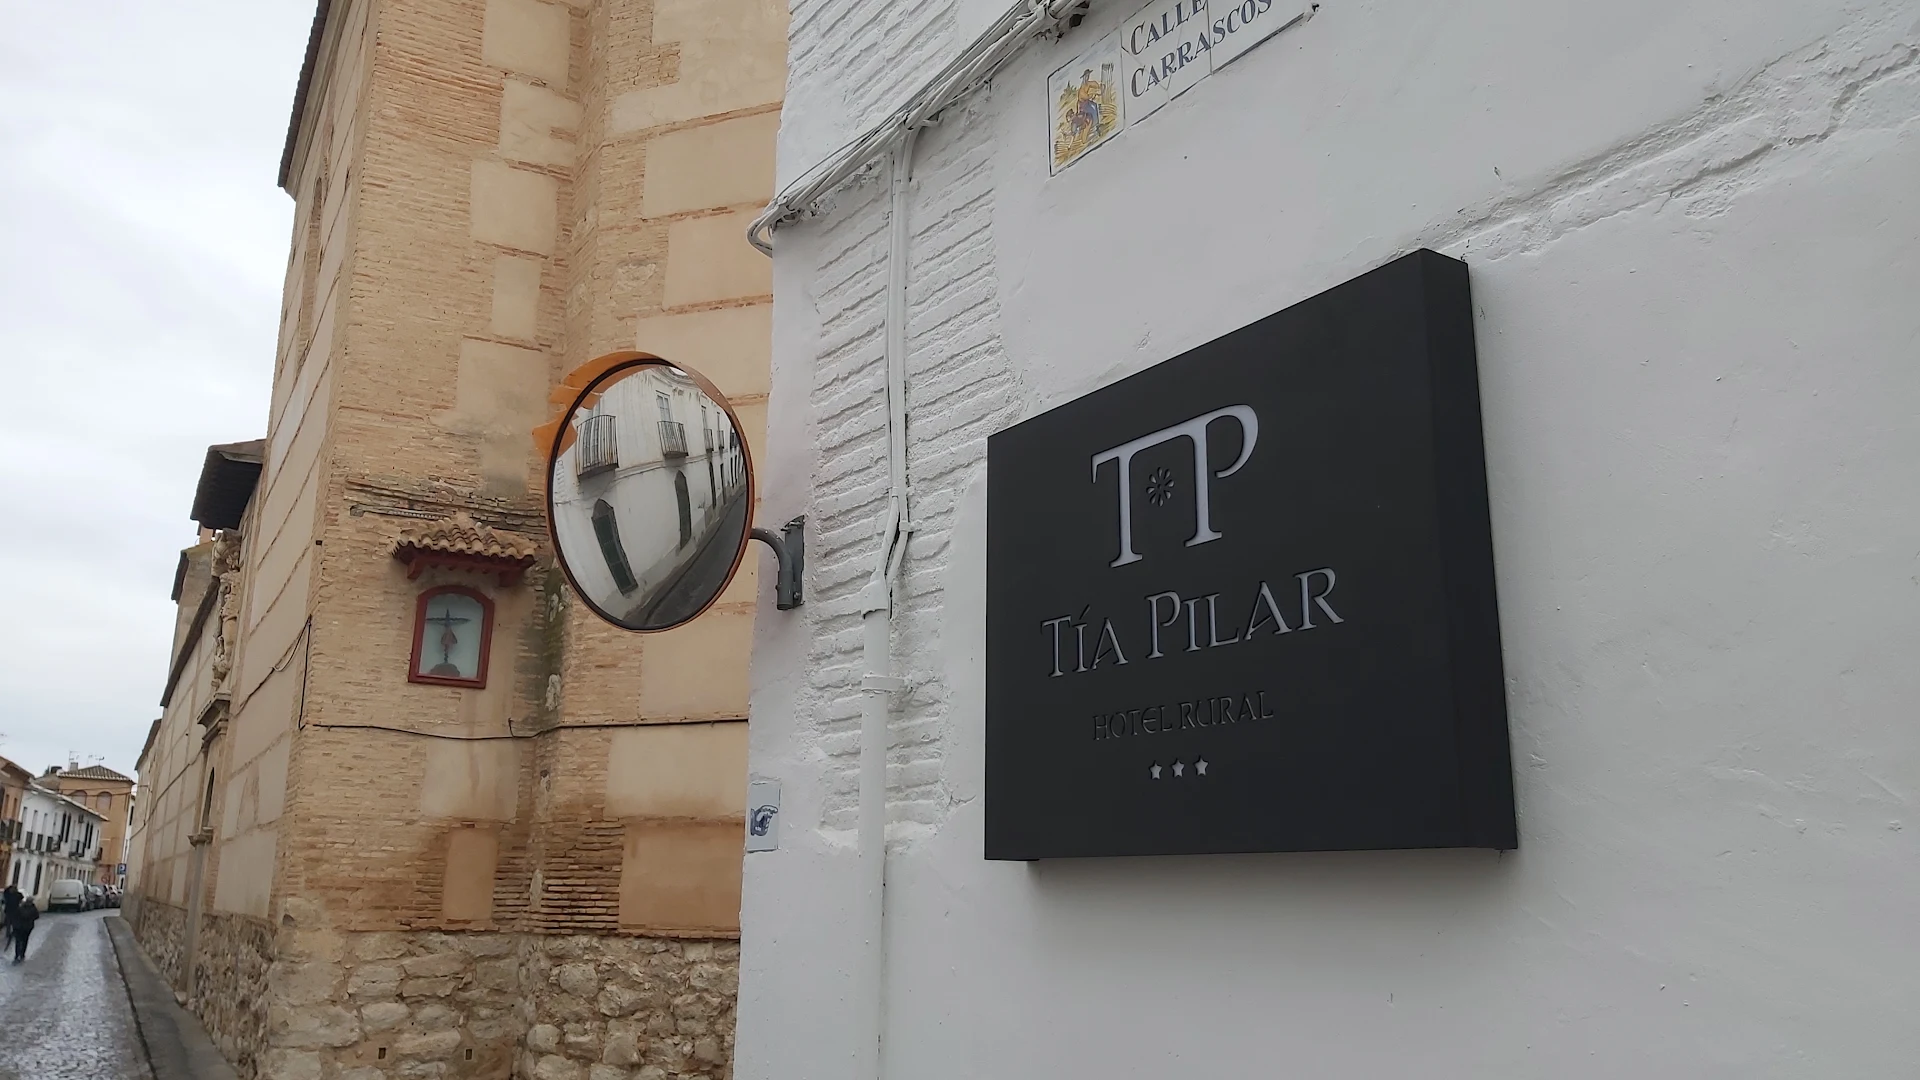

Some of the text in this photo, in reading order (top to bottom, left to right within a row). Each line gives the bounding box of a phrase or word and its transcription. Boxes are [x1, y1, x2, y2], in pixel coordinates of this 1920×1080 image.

[1130, 0, 1208, 55] CALLE
[1090, 403, 1259, 568] TP
[1040, 566, 1345, 678] TÍA PILAR
[1092, 690, 1275, 740] HOTEL RURAL
